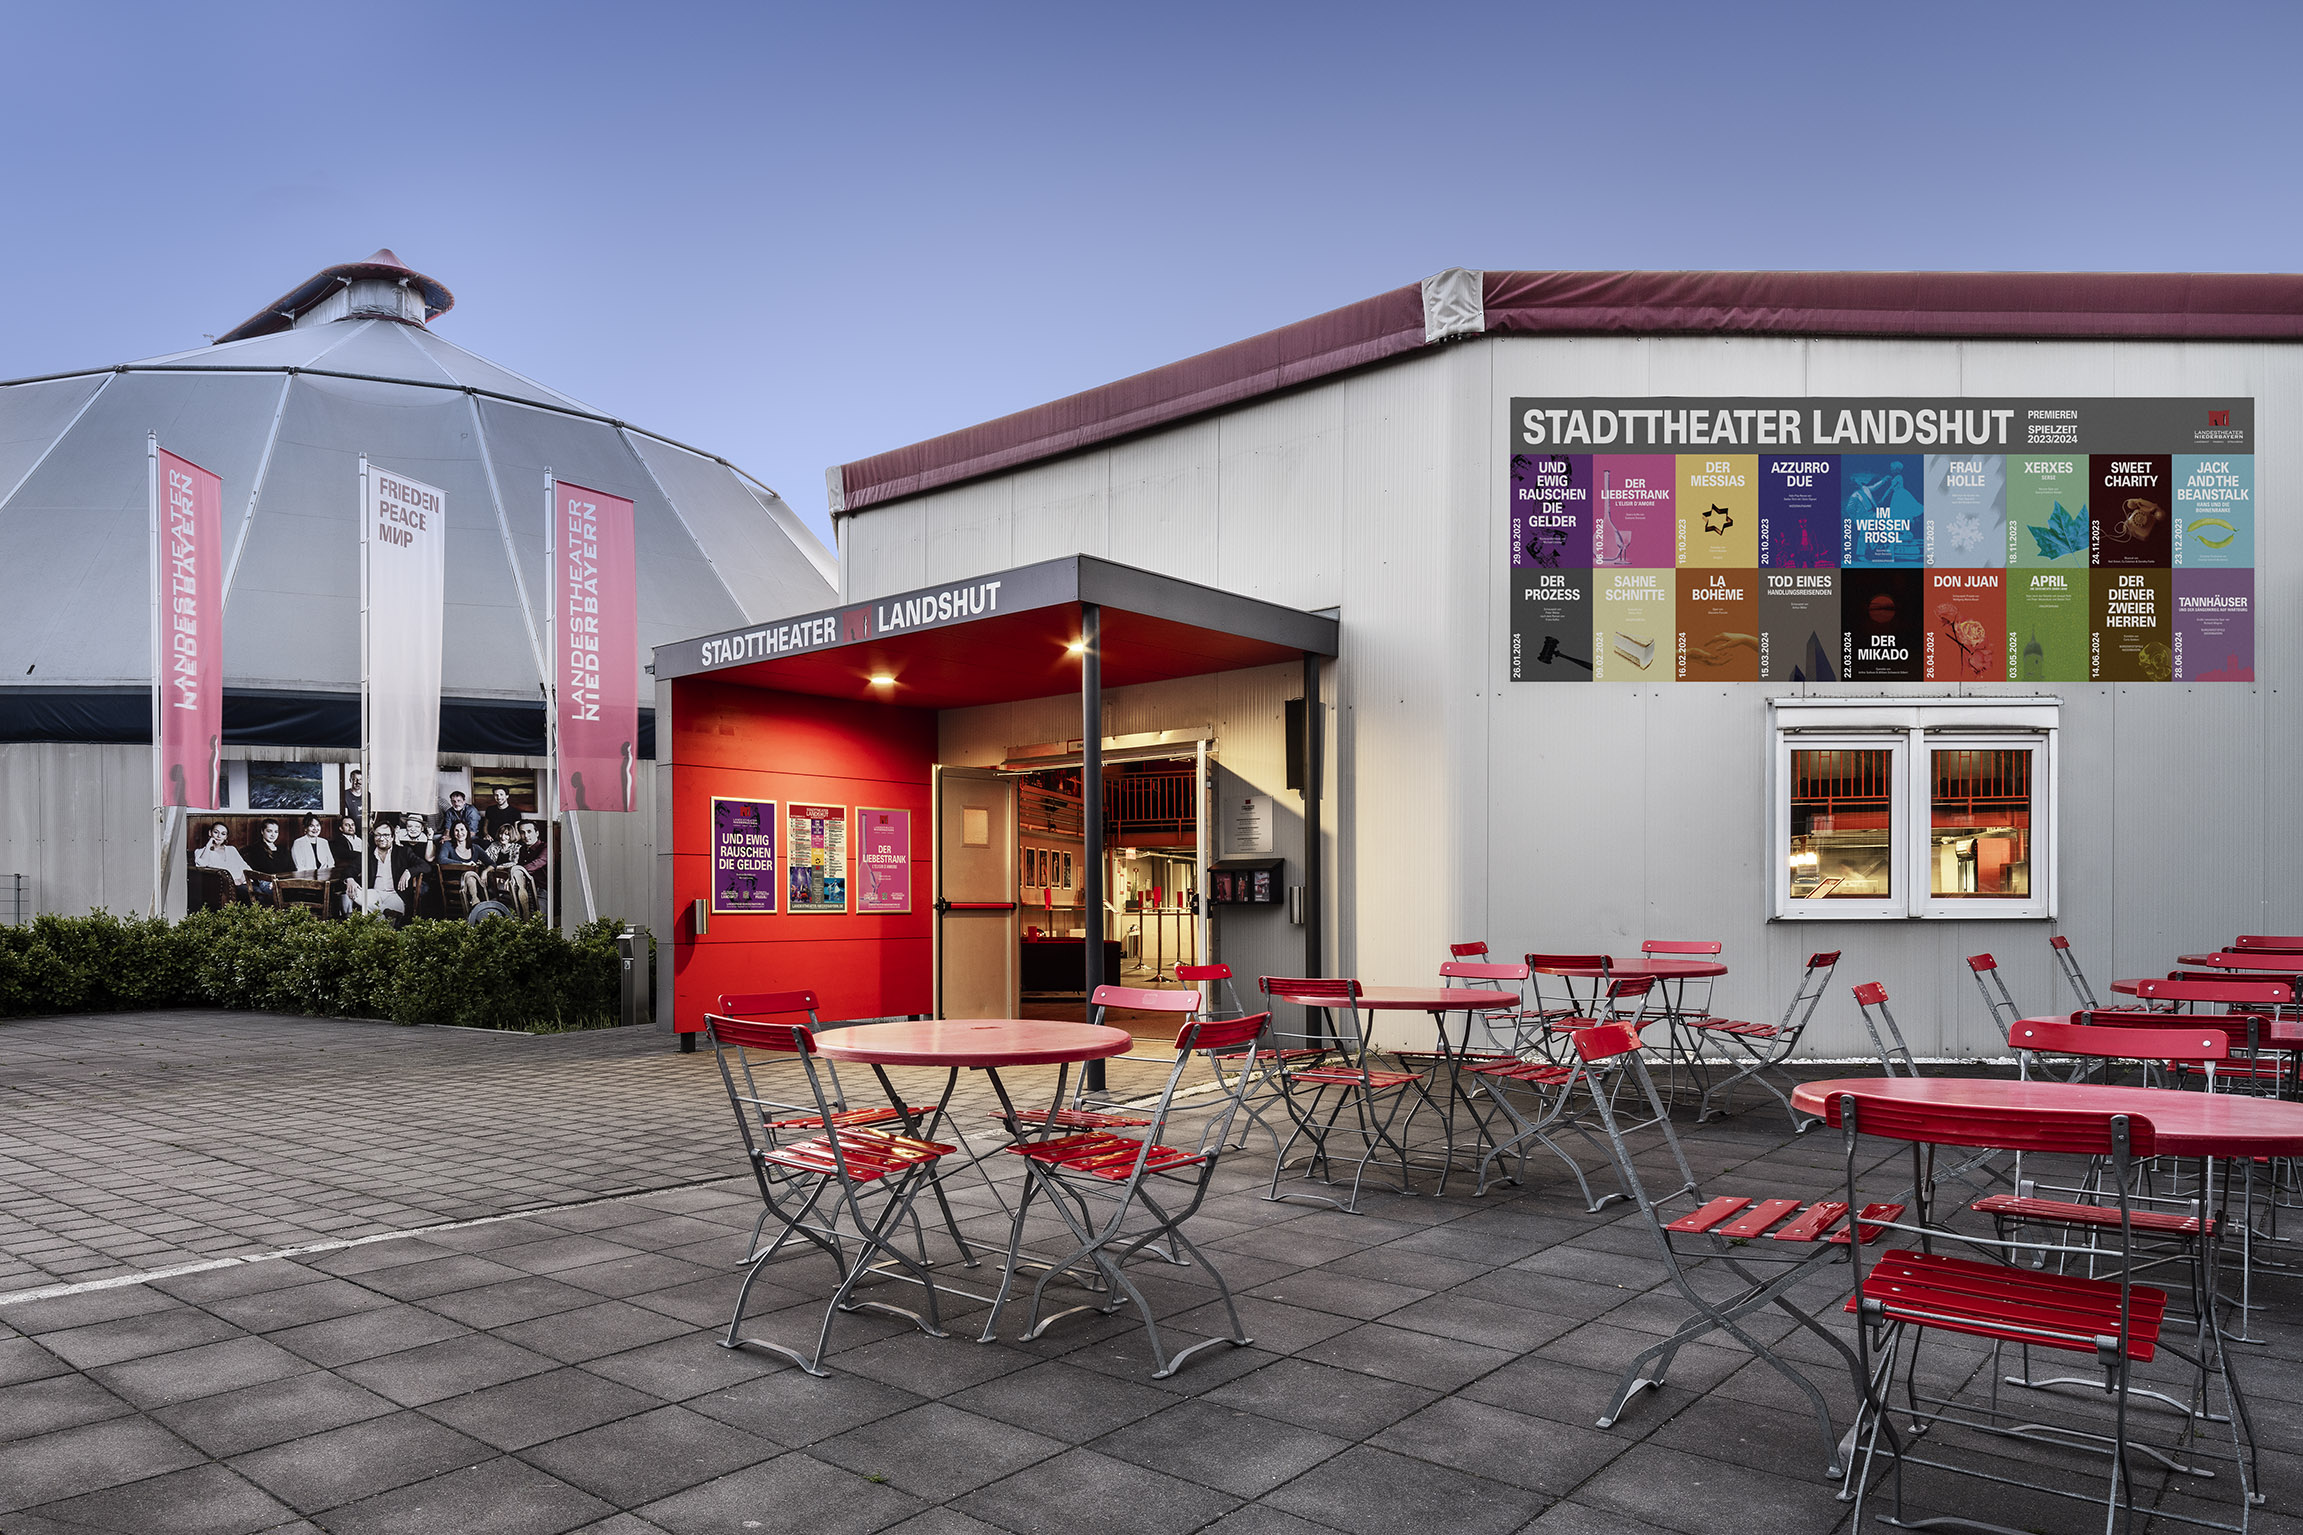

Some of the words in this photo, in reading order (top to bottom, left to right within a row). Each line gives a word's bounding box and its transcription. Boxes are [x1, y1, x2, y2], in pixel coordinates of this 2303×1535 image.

[2028, 410, 2078, 420] PREMIEREN
[1523, 409, 1801, 445] STADTTHEATER
[1814, 409, 2014, 445] LANDSHUT
[2028, 425, 2077, 434] SPIELZEIT
[2028, 435, 2078, 444] 2023/2024
[1538, 462, 1566, 473] UND
[1706, 462, 1730, 474] DER
[1771, 462, 1830, 474] AZZURRO
[1950, 462, 1982, 473] FRAU
[2024, 462, 2073, 474] XERXES
[2111, 462, 2152, 474] SWEET
[2197, 462, 2229, 474] JACK
[1537, 475, 1568, 487] EWIG
[1625, 478, 1646, 489] DER
[1690, 475, 1745, 487] MESSIAS
[1787, 475, 1813, 487] DUE
[1946, 475, 1985, 487] HOLLE
[2104, 475, 2158, 488] CHARITY
[2187, 475, 2215, 487] AND
[2216, 475, 2239, 487] THE
[380, 477, 439, 513] FRIEDEN
[1519, 488, 1586, 501] RAUSCHEN
[1601, 489, 1669, 500] LIEBESTRANK
[2177, 488, 2249, 501] BEANSTALK
[1543, 502, 1563, 514] DIE
[1876, 507, 1890, 518] IM
[380, 500, 426, 531] PEACE
[1529, 516, 1576, 528] GELDER
[1856, 519, 1910, 531] WEISSEN
[379, 523, 413, 548] МИР
[1513, 518, 1521, 565] 29.09.2023
[1596, 518, 1604, 565] 06.10.2023
[1761, 518, 1769, 565] 20.10.2023
[1844, 518, 1852, 565] 29.10.2023
[1865, 531, 1902, 543] RÖSSL
[2175, 518, 2183, 565] 23.12.2023
[1679, 519, 1687, 565] 19.10.2023
[1927, 520, 1935, 565] 04.11.2023
[2009, 520, 2018, 565] 18.11.2023
[2092, 520, 2100, 565] 24.11.2023
[1540, 576, 1565, 588] DER
[1614, 576, 1656, 588] SAHNE
[1710, 576, 1725, 588] LA
[1768, 576, 1793, 588] TOD
[1797, 576, 1832, 588] EINES
[1934, 576, 1961, 588] DON
[1964, 576, 1998, 588] JUAN
[2030, 576, 2067, 587] APRIL
[2119, 576, 2144, 587] DER
[169, 468, 190, 710] LANDESTHEATER
[181, 474, 198, 711] NIEDERBAYERN
[1525, 589, 1580, 601] PROZESS
[1605, 589, 1665, 601] SCHNITTE
[1692, 586, 1744, 601] BOHÈME
[2108, 589, 2155, 601] DIENER
[2178, 594, 2248, 607] TANNHÄUSER
[568, 499, 585, 720] LANDESTHEATER
[583, 502, 600, 721] NIEDERBAYERN
[2108, 602, 2154, 614] ZWEIER
[701, 616, 836, 666] STADTTHEATER
[878, 581, 1001, 633] LANDSHUT
[2106, 616, 2156, 628] HERREN
[1871, 636, 1896, 647] DER
[1513, 633, 1521, 679] 26.01.2024
[1596, 632, 1604, 679] 09.02.2024
[1679, 632, 1687, 679] 16.02.2024
[1761, 632, 1769, 679] 15.03.2024
[1844, 632, 1852, 679] 22.03.2024
[1858, 649, 1909, 661] MIKADO
[1927, 632, 1935, 679] 26.04.2024
[2009, 632, 2018, 679] 03.05.2024
[2092, 632, 2100, 679] 14.06.2024
[2175, 632, 2183, 679] 28.06.2024
[722, 833, 743, 844] UND
[746, 834, 769, 845] EWIG
[720, 846, 771, 858] RAUSCHEN
[878, 845, 891, 853] DER
[719, 859, 734, 869] DIE
[737, 860, 773, 870] GELDER
[863, 855, 906, 863] LIEBESTRANK
